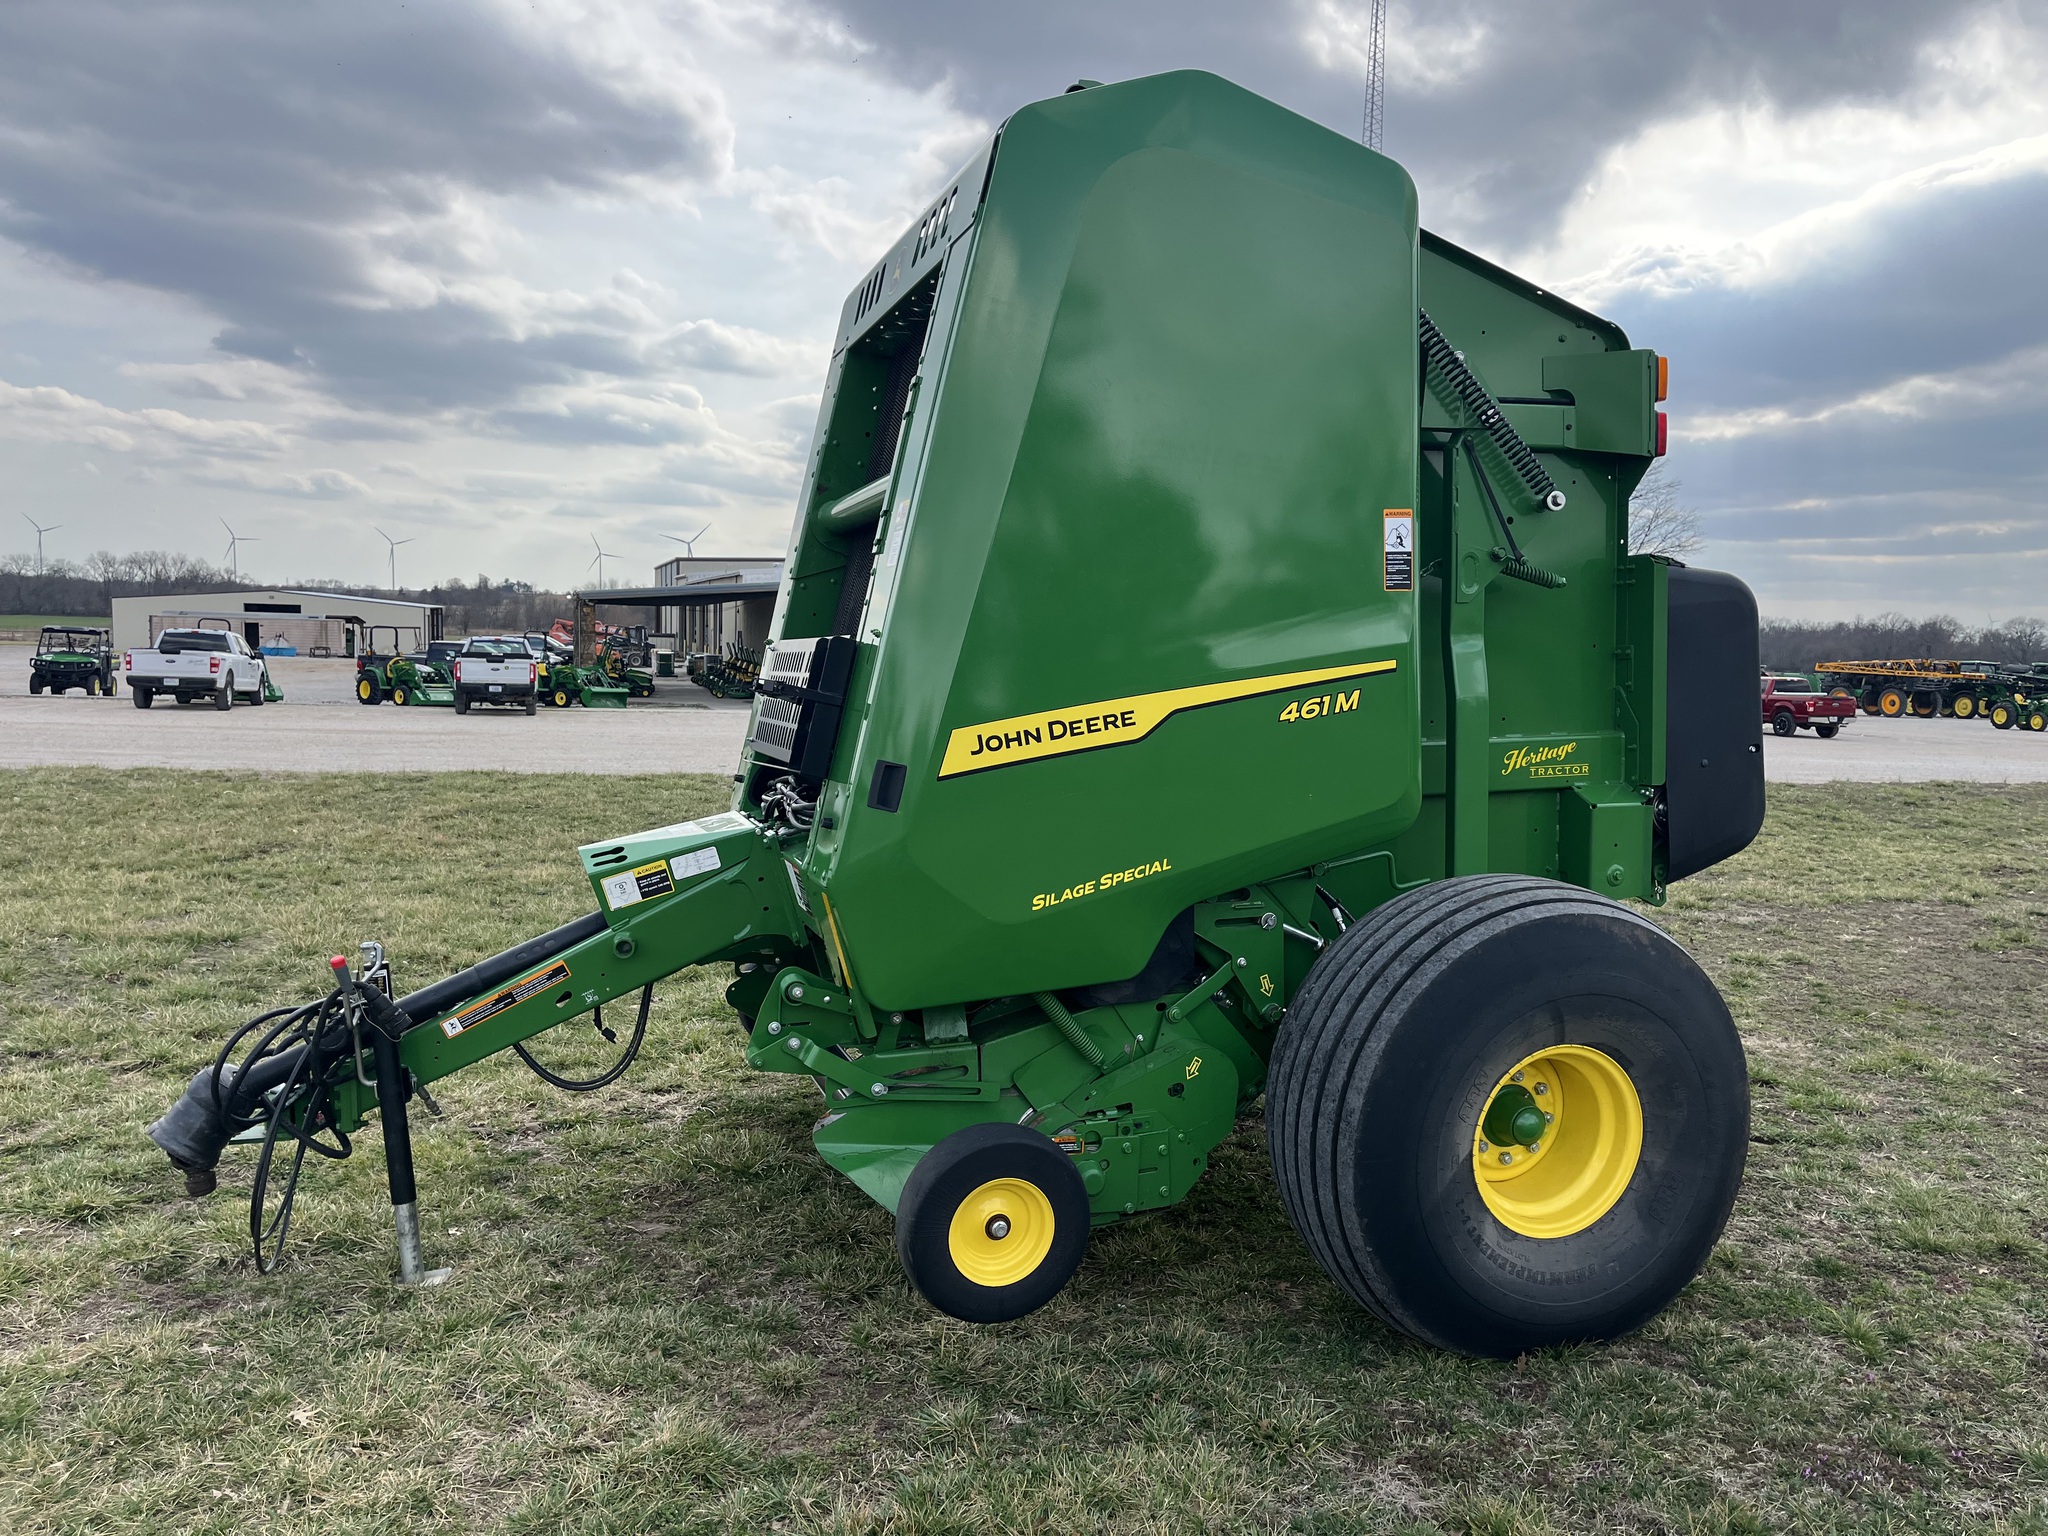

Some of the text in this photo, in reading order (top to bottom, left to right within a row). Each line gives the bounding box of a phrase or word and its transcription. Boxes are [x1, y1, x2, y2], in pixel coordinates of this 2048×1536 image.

[970, 710, 1136, 756] JOHN DEERE
[1501, 742, 1577, 775] Heritage
[1529, 765, 1589, 776] TRACTOR
[641, 864, 663, 874] CAUTION
[1031, 858, 1172, 911] SILAGE SPECIAL
